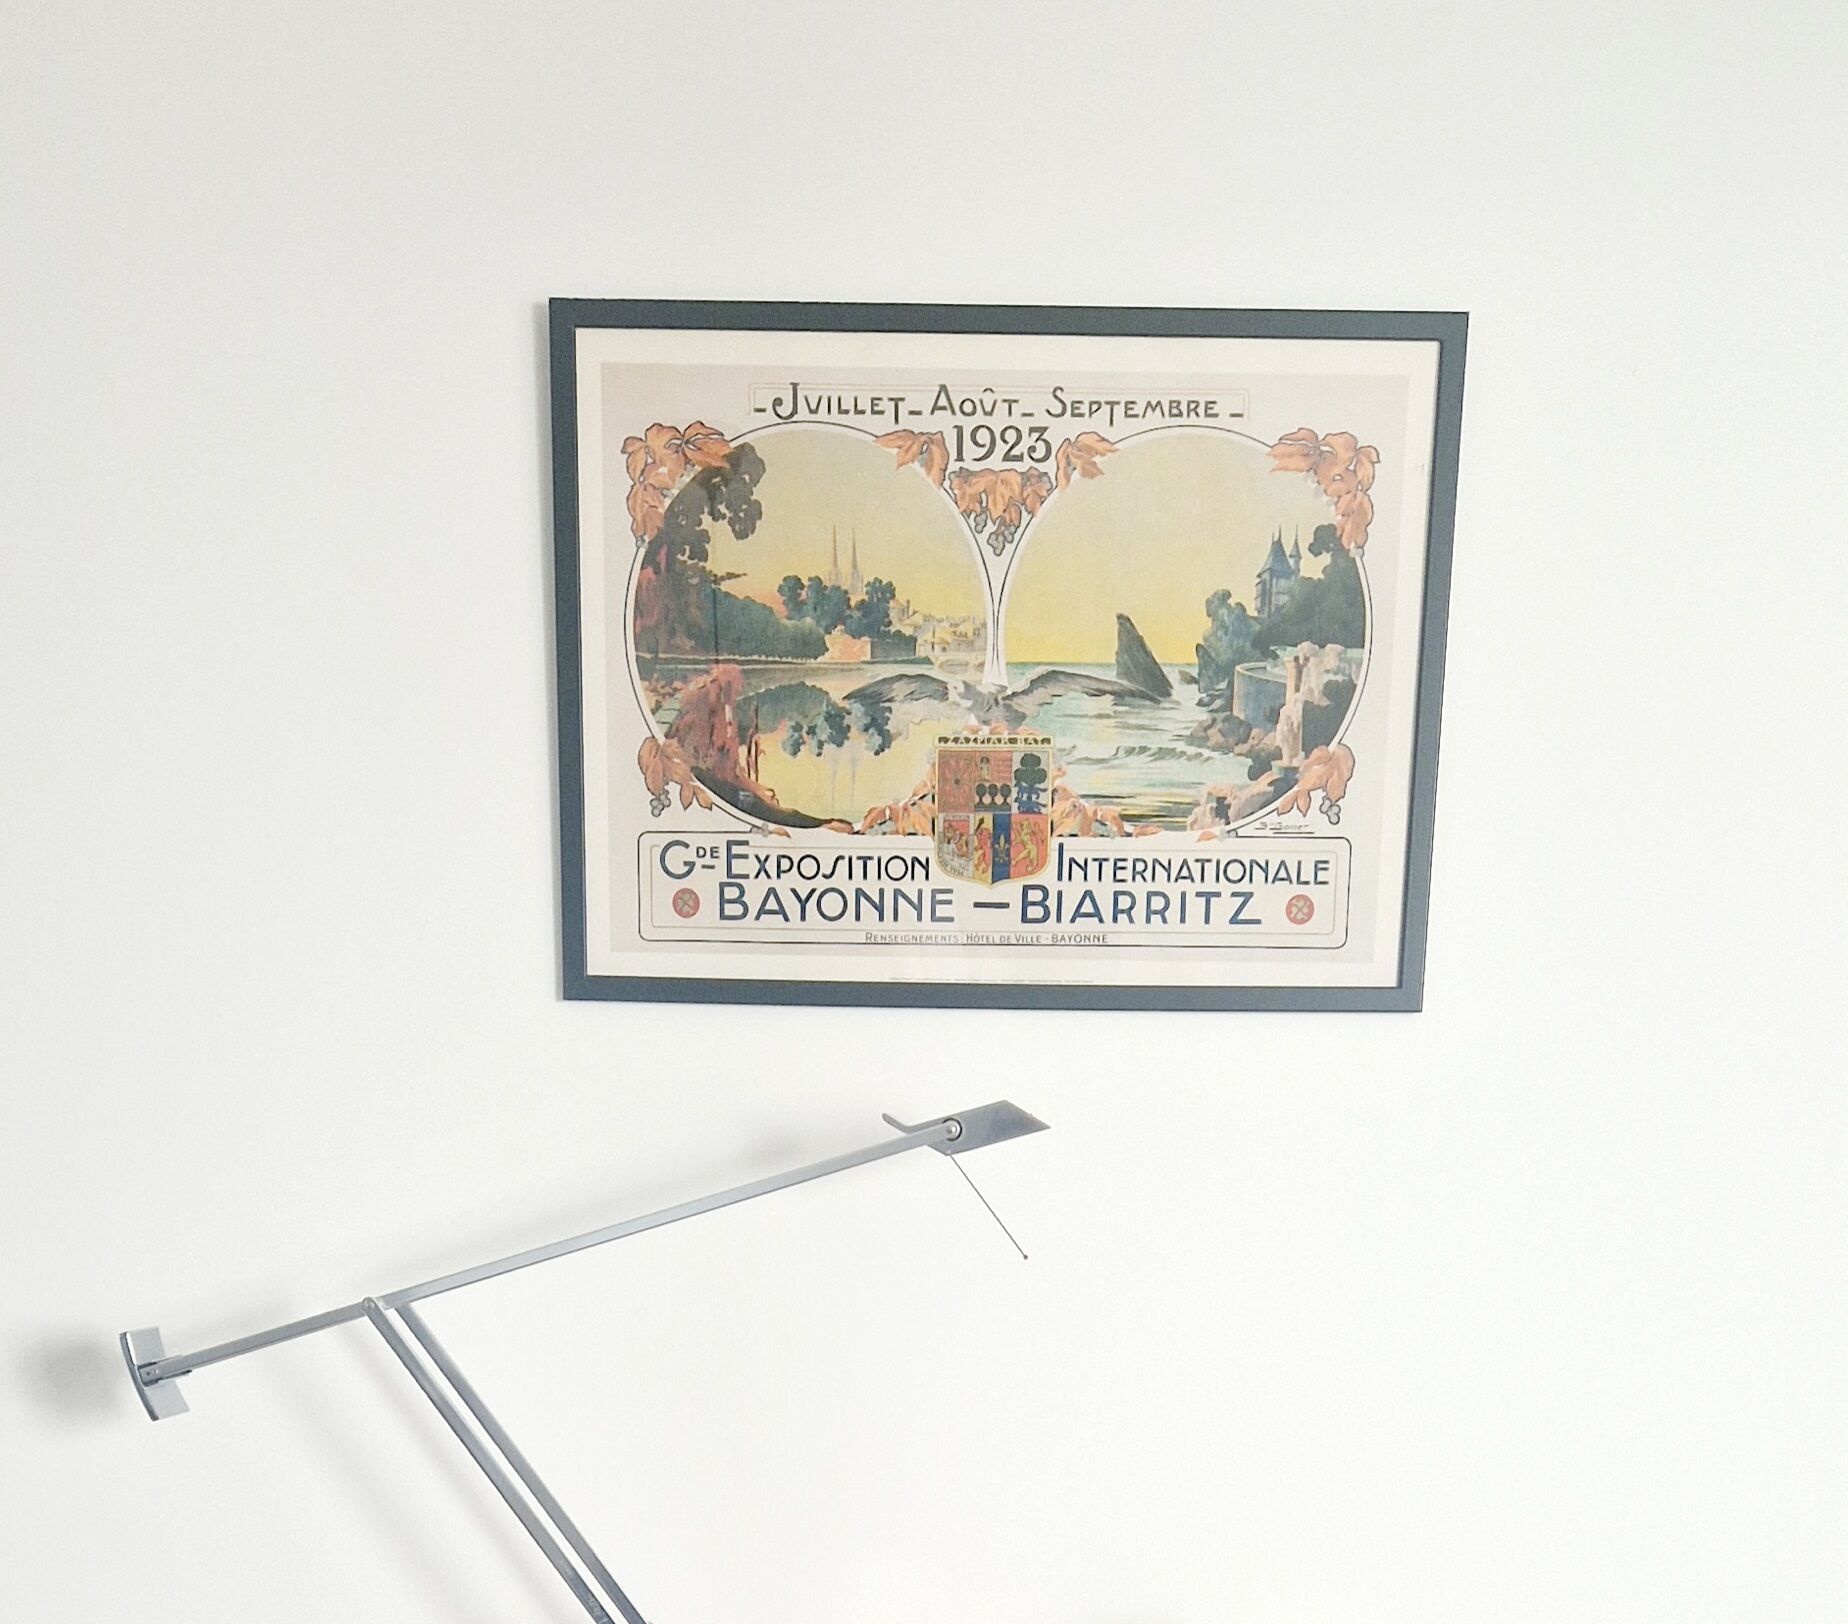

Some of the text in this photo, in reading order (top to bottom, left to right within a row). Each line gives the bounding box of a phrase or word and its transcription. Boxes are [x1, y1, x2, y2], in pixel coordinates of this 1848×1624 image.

[930, 383, 1020, 417] AOÛT
[1045, 386, 1220, 427] SEPTEMBRE
[952, 424, 1052, 463] 1923
[725, 839, 930, 881] EXPOSITION
[1056, 842, 1330, 886] INTERNATIONALE
[718, 881, 1263, 926] BAYONNE BIARRITZ
[1051, 934, 1109, 944] BAYONNE
